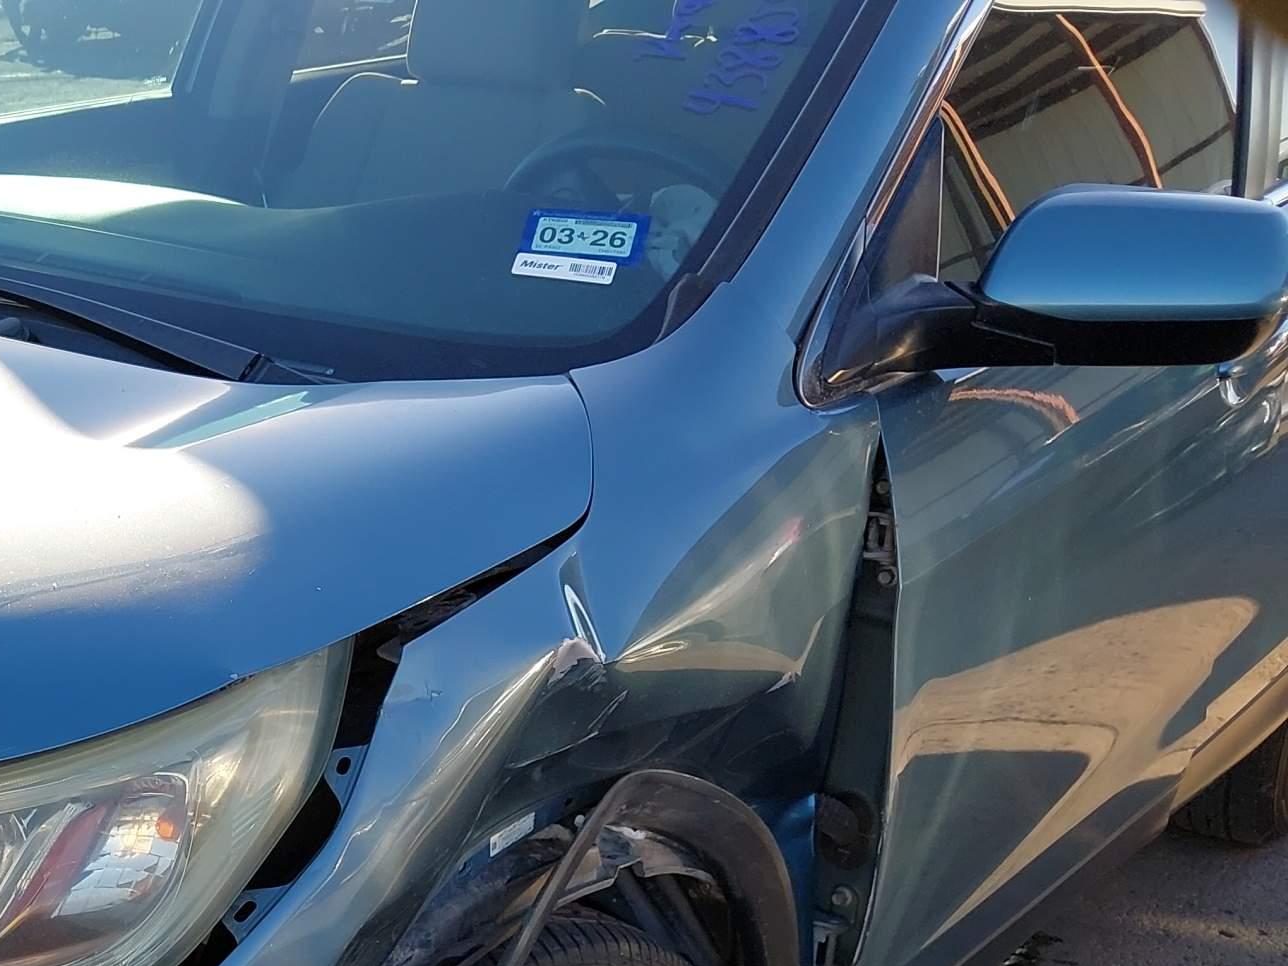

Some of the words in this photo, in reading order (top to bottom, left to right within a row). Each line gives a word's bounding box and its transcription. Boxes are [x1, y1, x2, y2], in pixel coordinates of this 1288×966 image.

[539, 227, 575, 244] 03
[589, 230, 628, 248] 26
[520, 259, 563, 271] Mister
